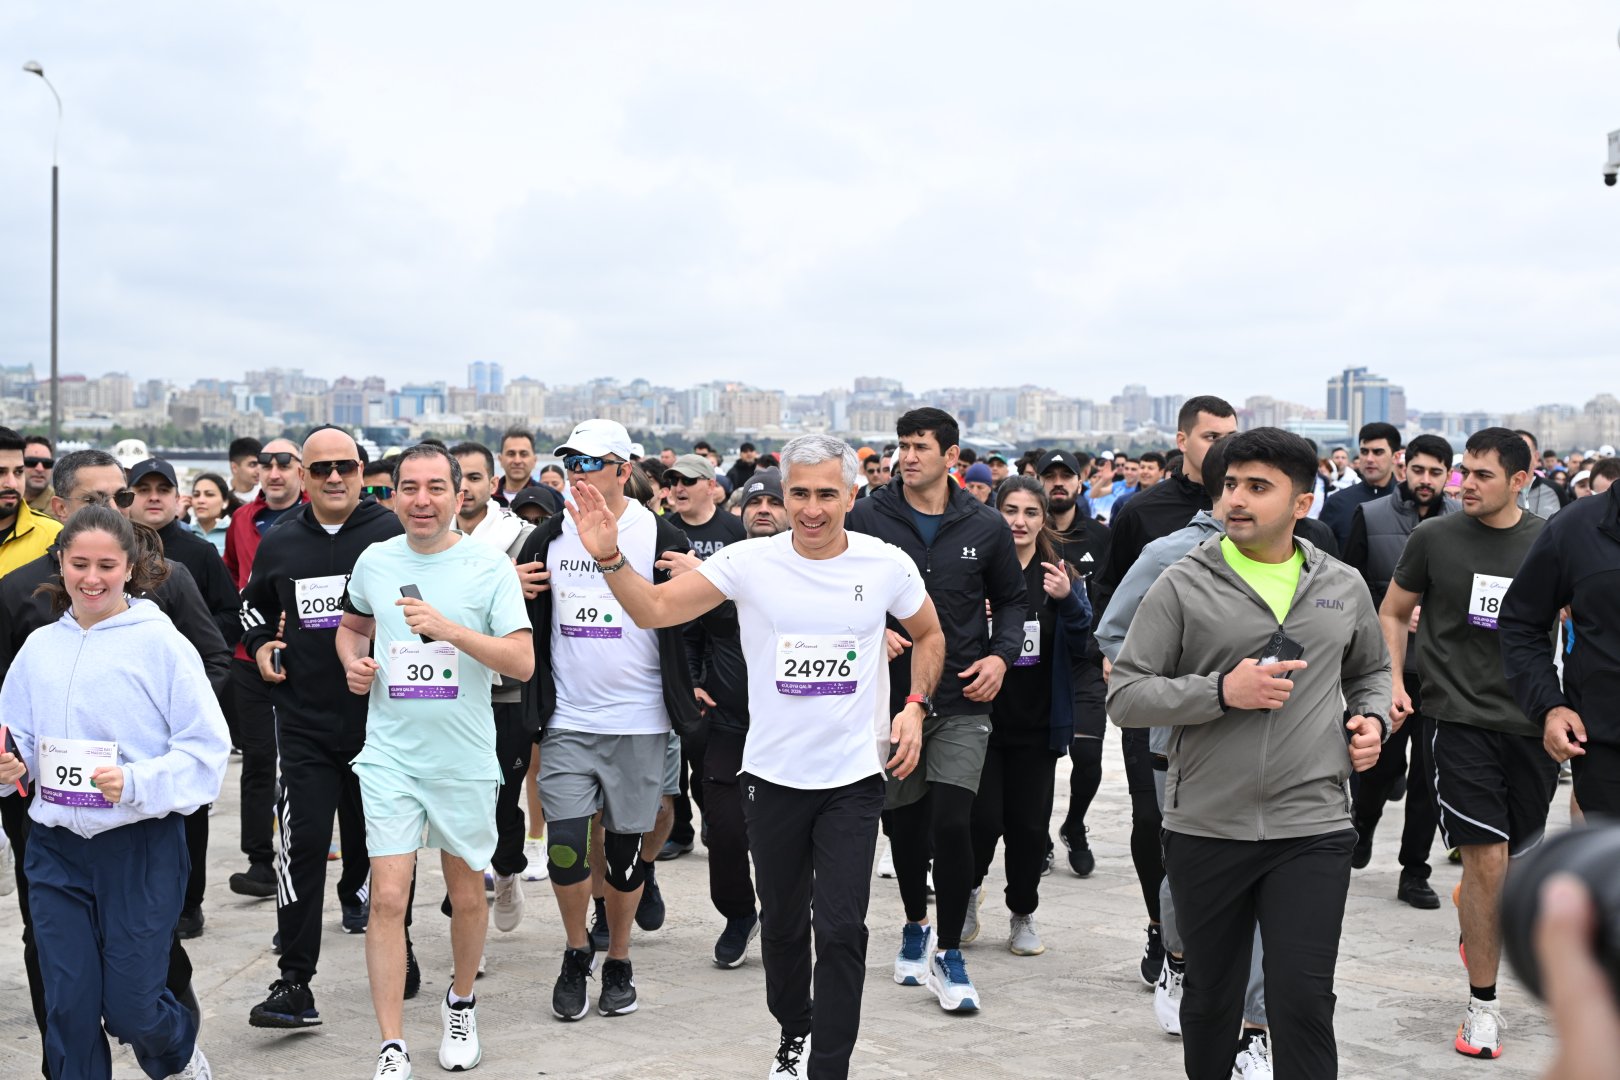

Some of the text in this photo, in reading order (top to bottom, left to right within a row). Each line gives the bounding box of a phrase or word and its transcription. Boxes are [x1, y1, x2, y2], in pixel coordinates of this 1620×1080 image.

[1316, 598, 1344, 611] RUN
[1480, 596, 1499, 613] 18
[575, 607, 598, 623] 49
[406, 663, 434, 681] 30
[784, 658, 851, 678] 24976
[56, 765, 82, 787] 95
